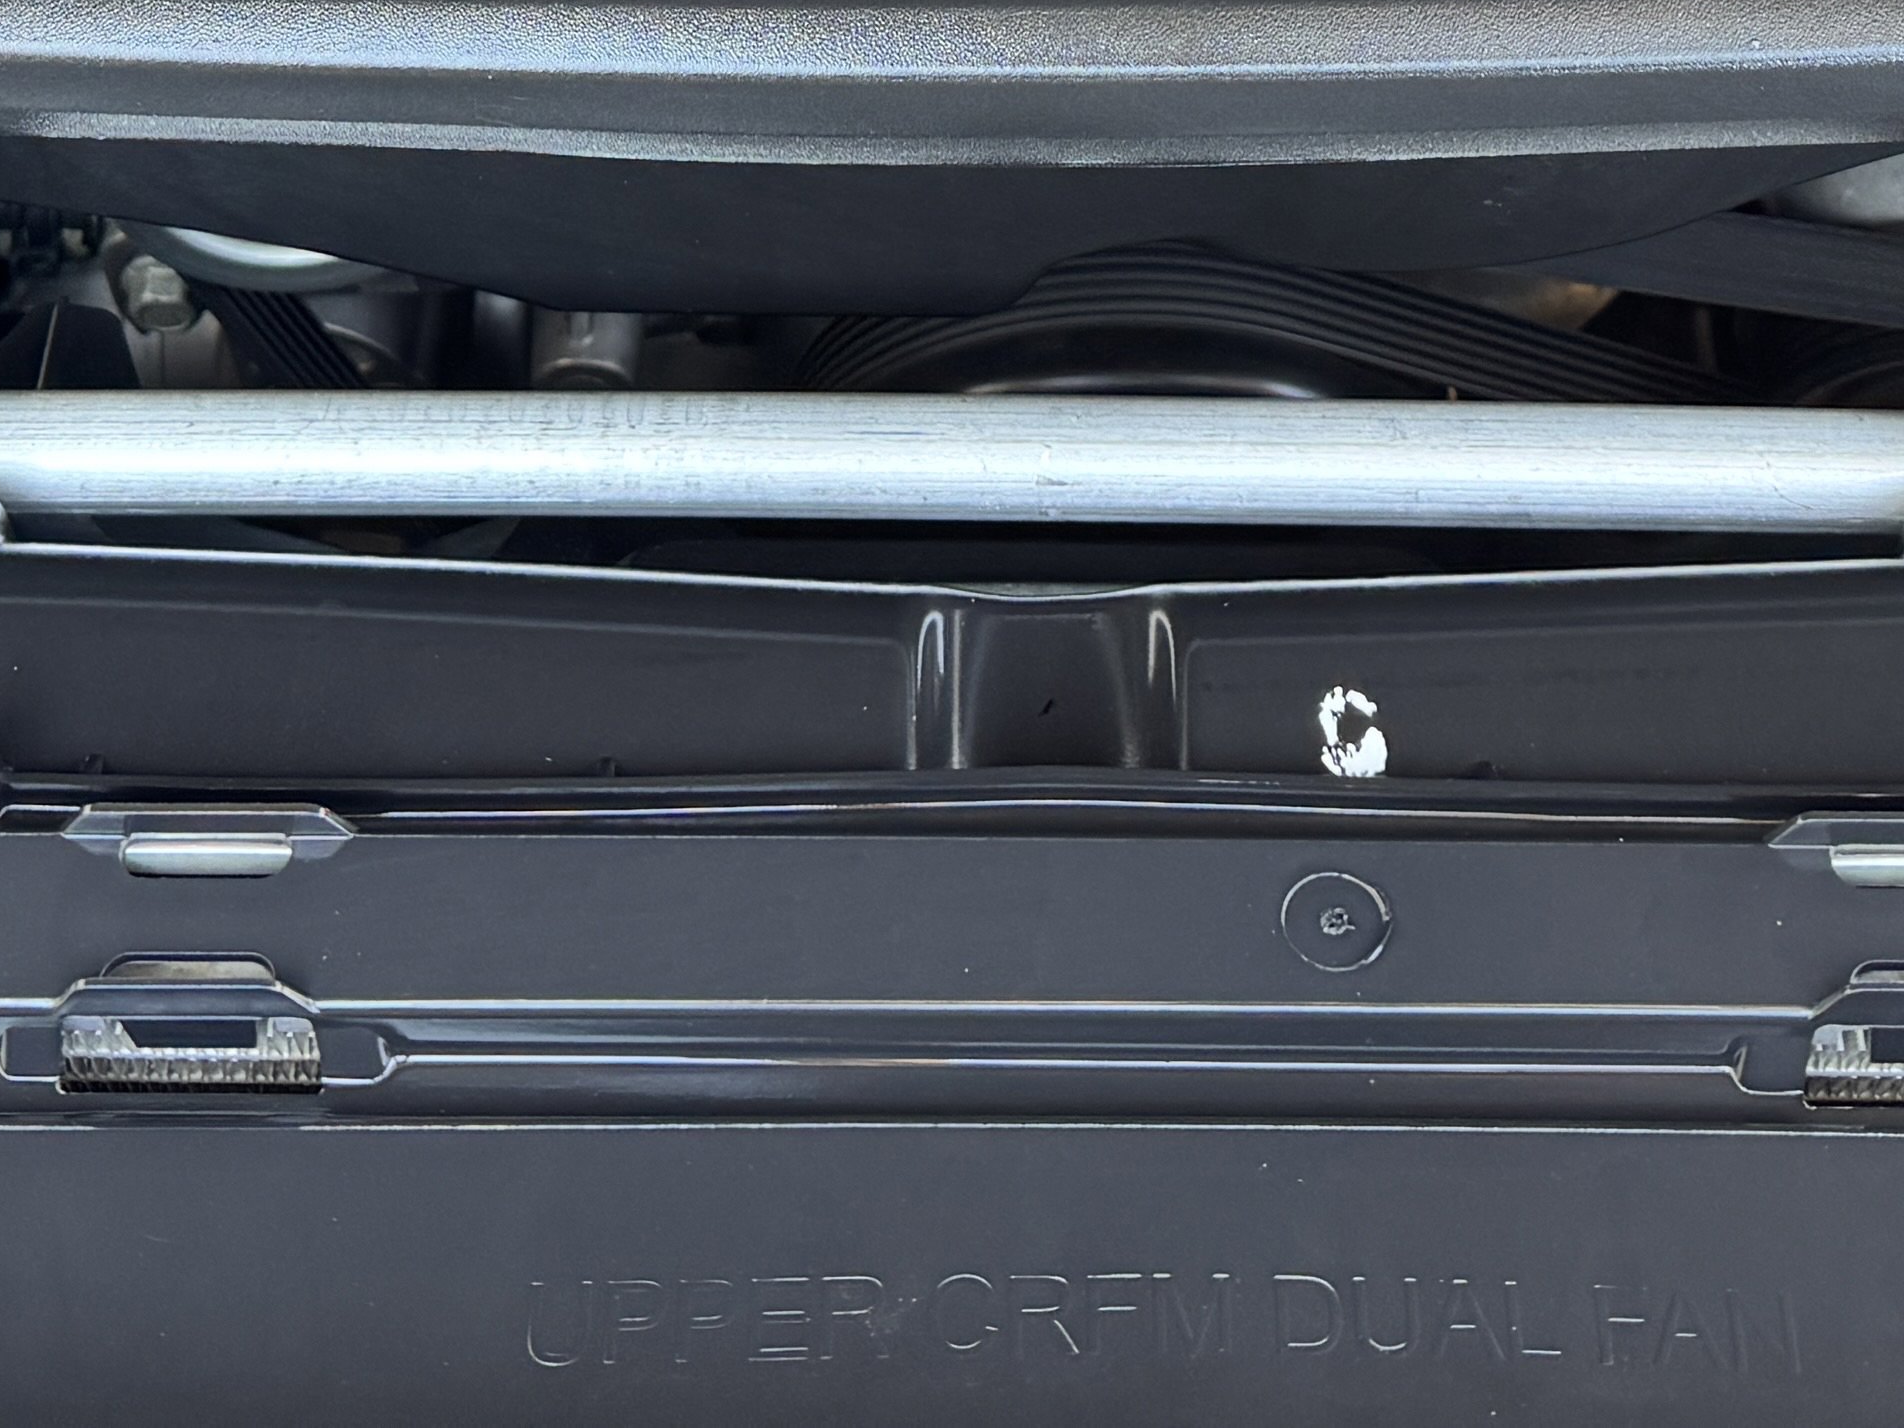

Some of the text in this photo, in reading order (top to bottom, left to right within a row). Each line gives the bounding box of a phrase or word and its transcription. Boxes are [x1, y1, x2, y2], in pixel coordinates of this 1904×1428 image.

[525, 1272, 1804, 1376] UPPER CRFM DUAL FAN
